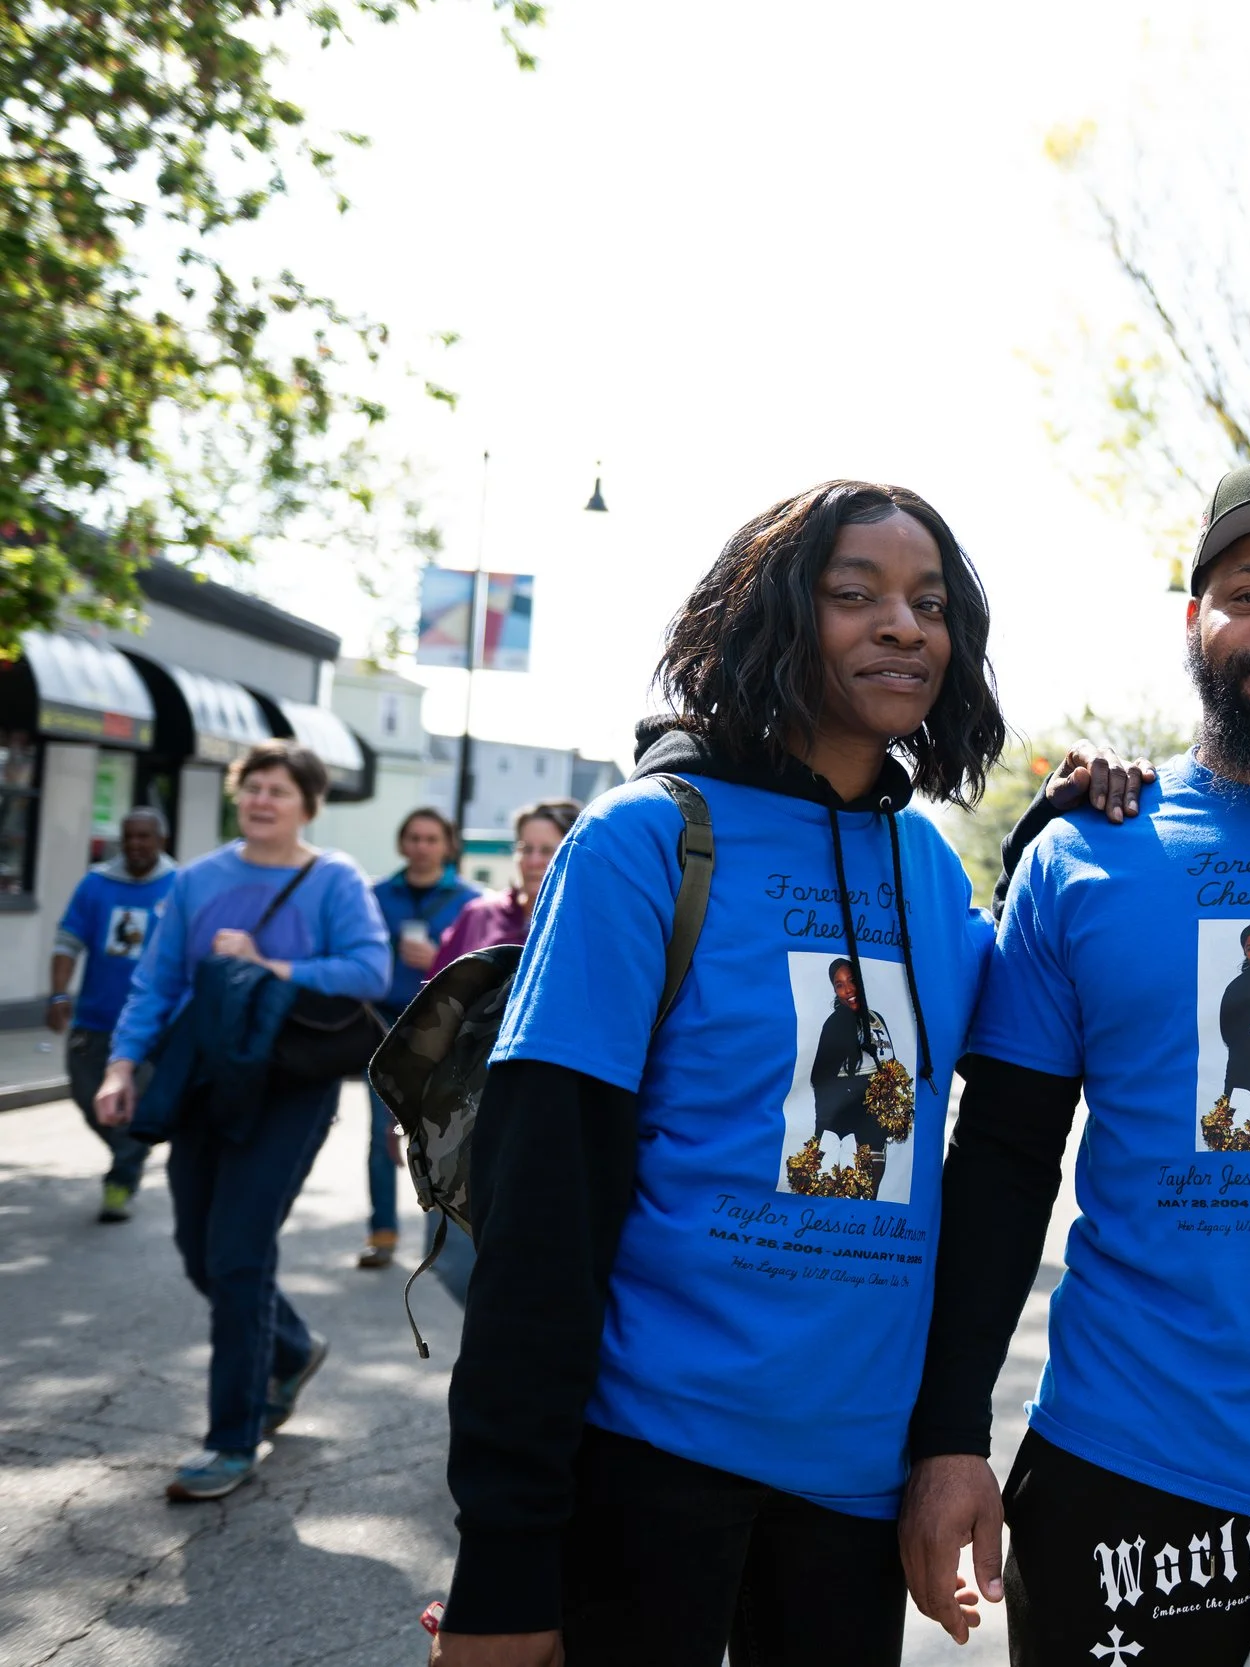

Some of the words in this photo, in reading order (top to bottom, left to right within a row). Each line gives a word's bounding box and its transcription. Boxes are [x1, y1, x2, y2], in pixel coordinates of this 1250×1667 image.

[877, 882, 912, 915] Or
[1156, 1165, 1212, 1195] Taylor
[712, 1193, 788, 1229] Taylor
[794, 1208, 867, 1238] Jessica
[872, 1215, 927, 1242] Wilkinson
[1157, 1199, 1187, 1208] MAY
[1210, 1199, 1249, 1209] 2004
[1197, 1221, 1231, 1237] Legacy
[709, 1228, 752, 1244] MAY
[782, 1241, 823, 1255] 2004
[833, 1248, 894, 1261] JANUARY
[756, 1260, 798, 1280] Legacy
[802, 1266, 830, 1280] Will
[830, 1269, 865, 1288] Always
[1152, 1603, 1201, 1619] Embrace
[1205, 1598, 1223, 1609] the
